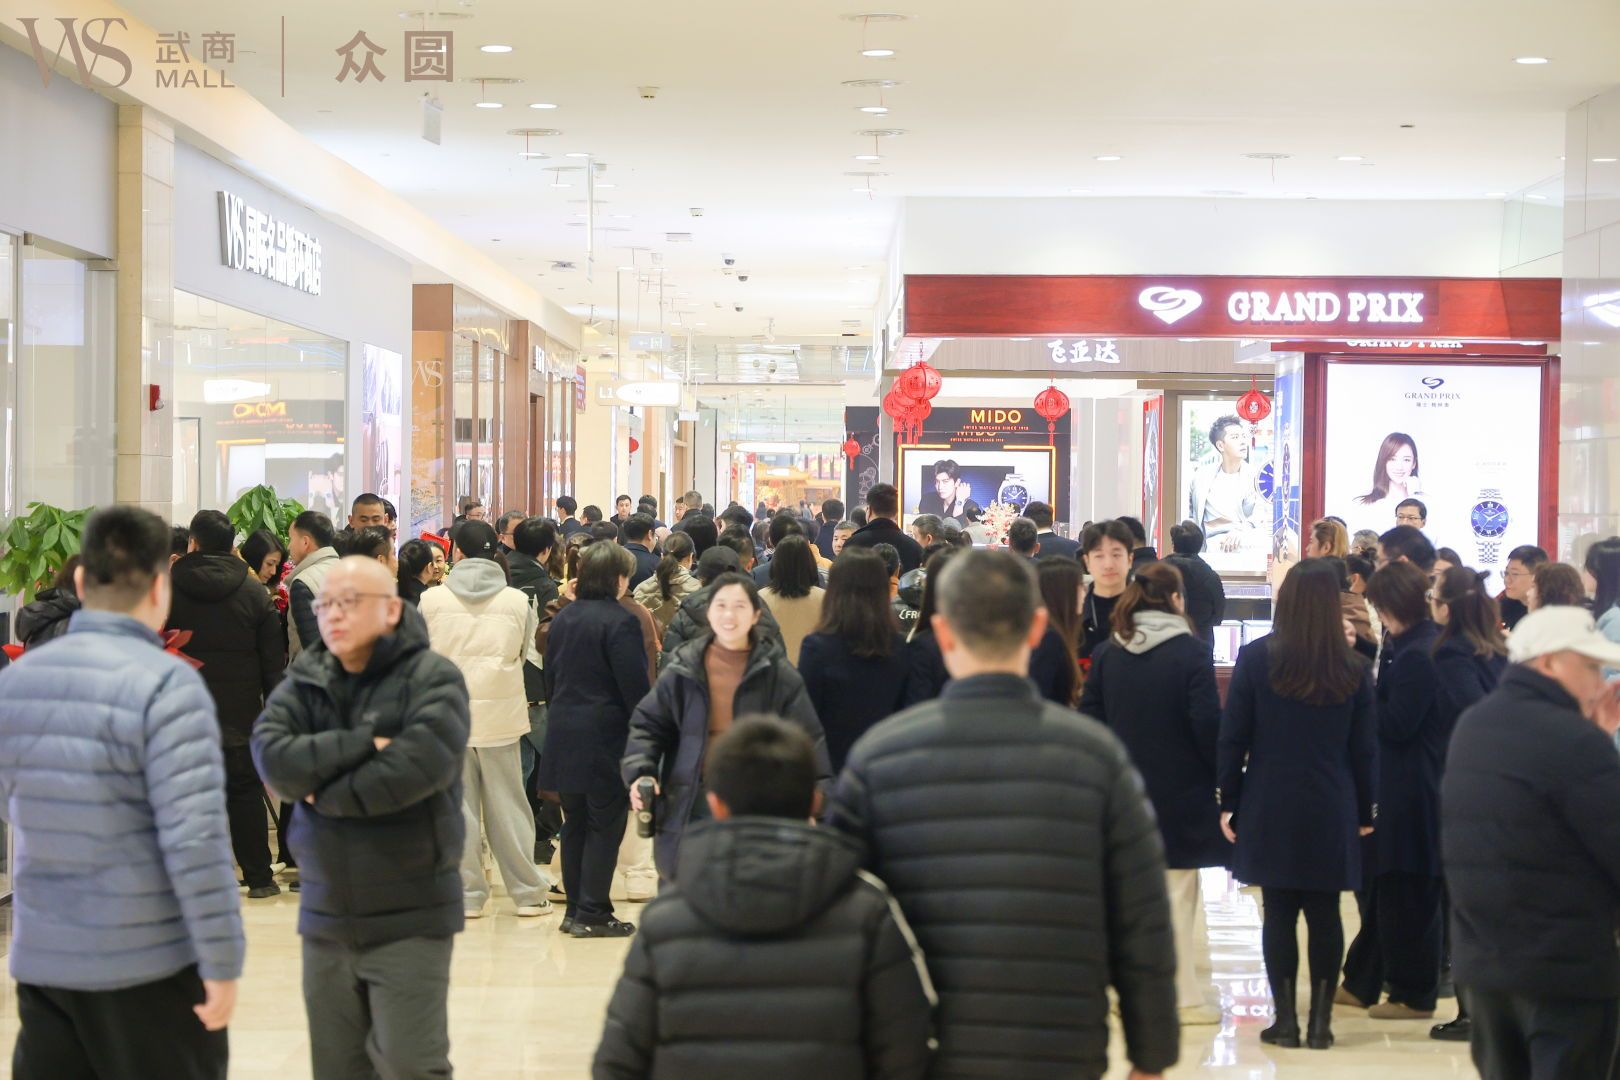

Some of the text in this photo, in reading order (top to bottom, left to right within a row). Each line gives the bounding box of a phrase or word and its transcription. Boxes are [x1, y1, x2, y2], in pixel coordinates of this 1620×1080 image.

[1227, 291, 1424, 324] GRAND PRIX
[1047, 338, 1121, 364] 飞亚达
[1439, 392, 1461, 400] PRIX
[971, 409, 1022, 424] MIDO
